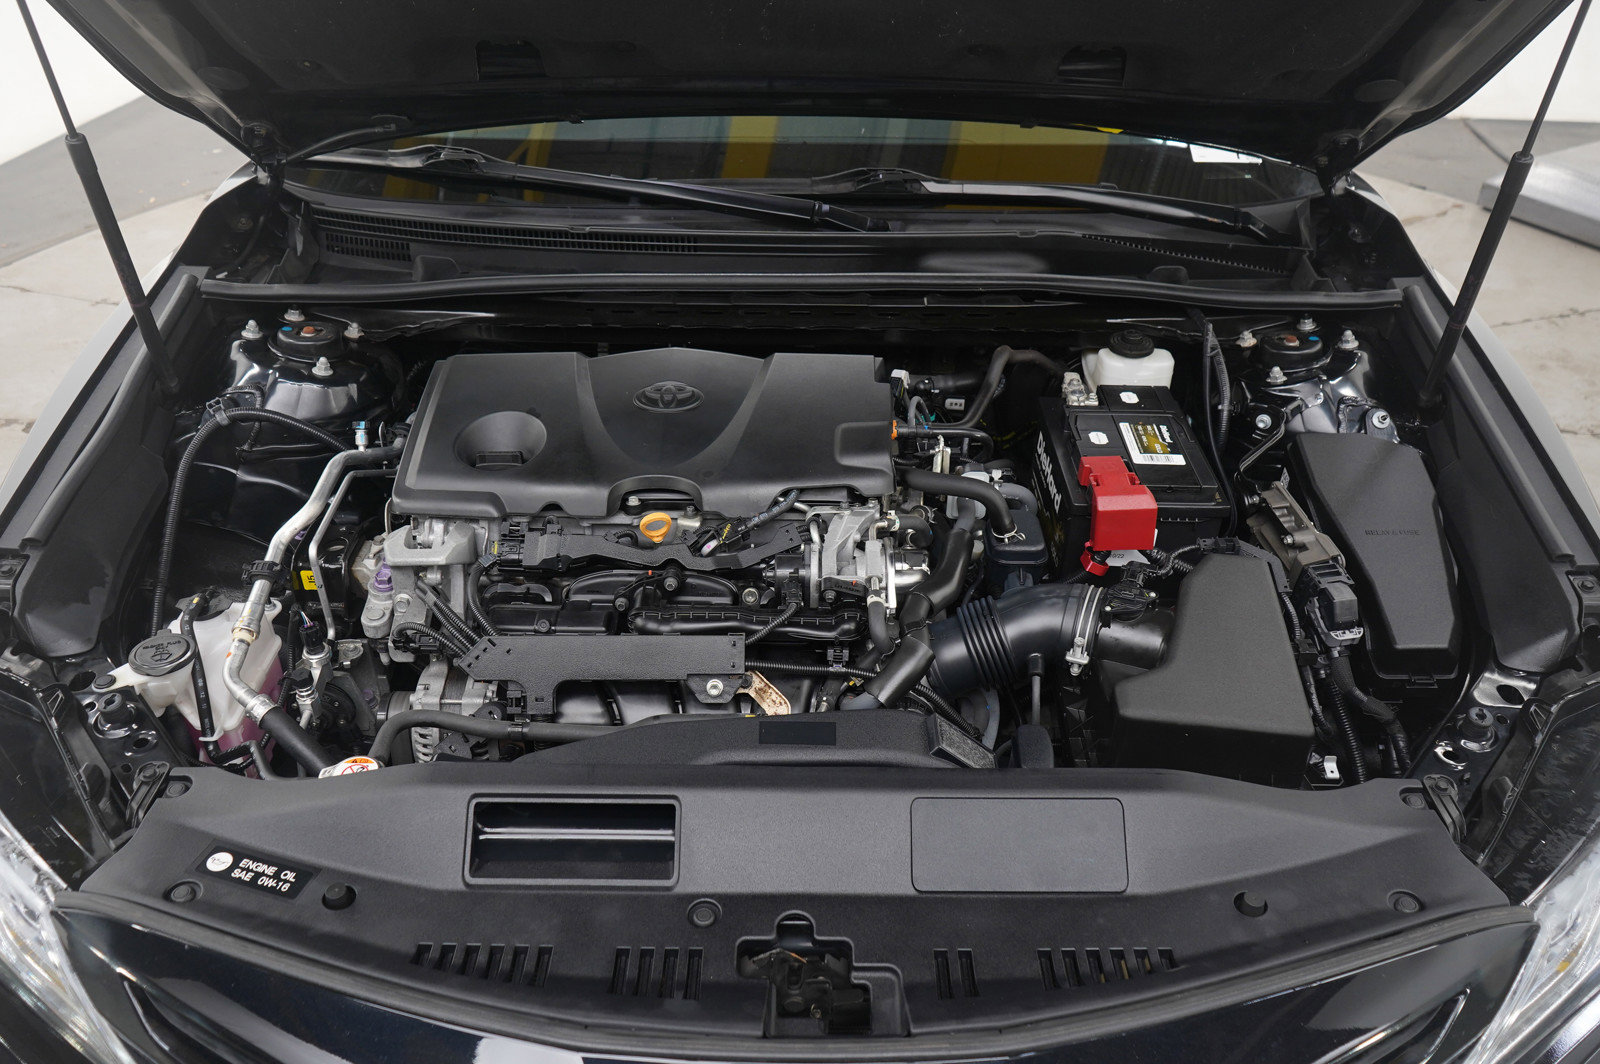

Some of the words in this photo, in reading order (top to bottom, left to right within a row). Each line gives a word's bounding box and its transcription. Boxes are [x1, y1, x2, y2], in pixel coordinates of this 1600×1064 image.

[1037, 431, 1061, 514] DieHard
[231, 868, 255, 882] SAE
[257, 876, 291, 892] 0W-16
[239, 858, 278, 876] ENGINE
[280, 870, 296, 882] OIL
